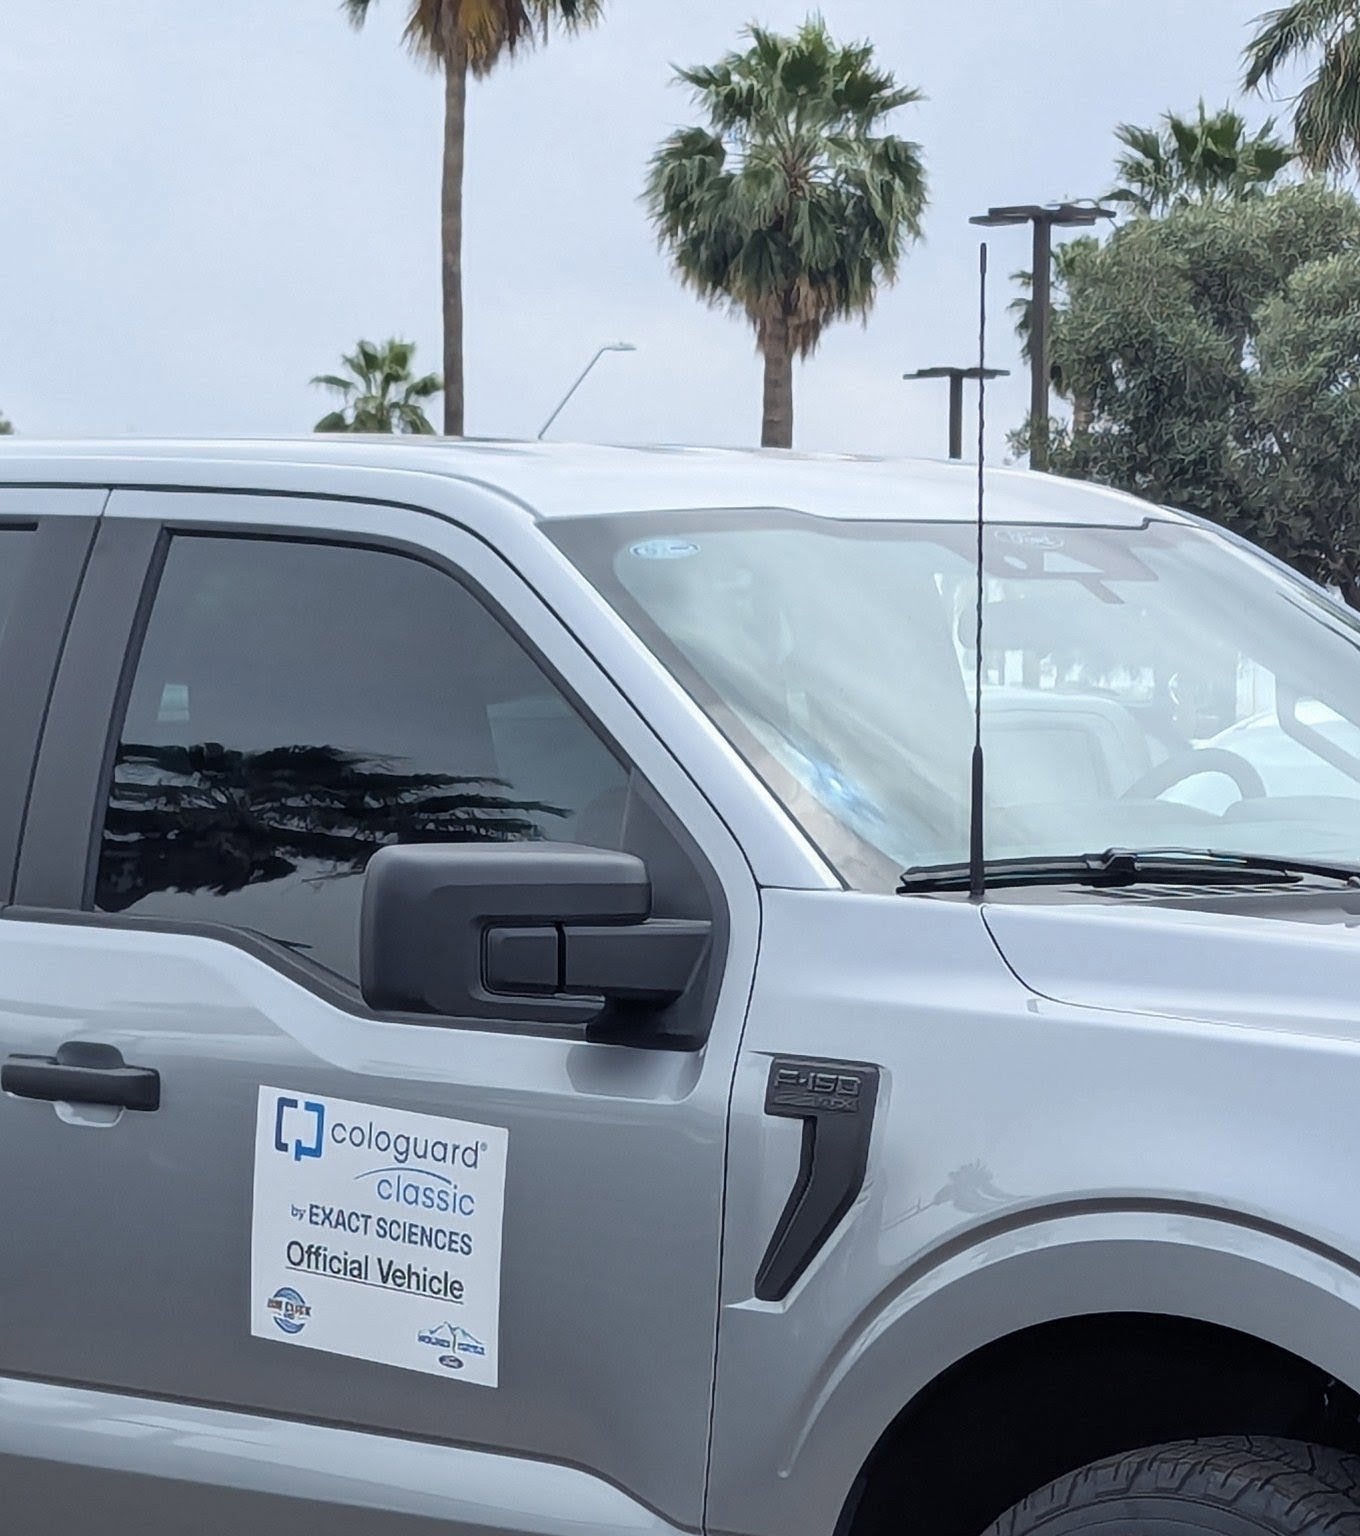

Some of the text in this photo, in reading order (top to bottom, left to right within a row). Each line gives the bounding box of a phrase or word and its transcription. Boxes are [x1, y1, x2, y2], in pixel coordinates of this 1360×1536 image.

[377, 1174, 475, 1215] classic
[291, 1203, 473, 1256] by EXACT SCIENCES
[287, 1240, 464, 1299] Official Vehicle
